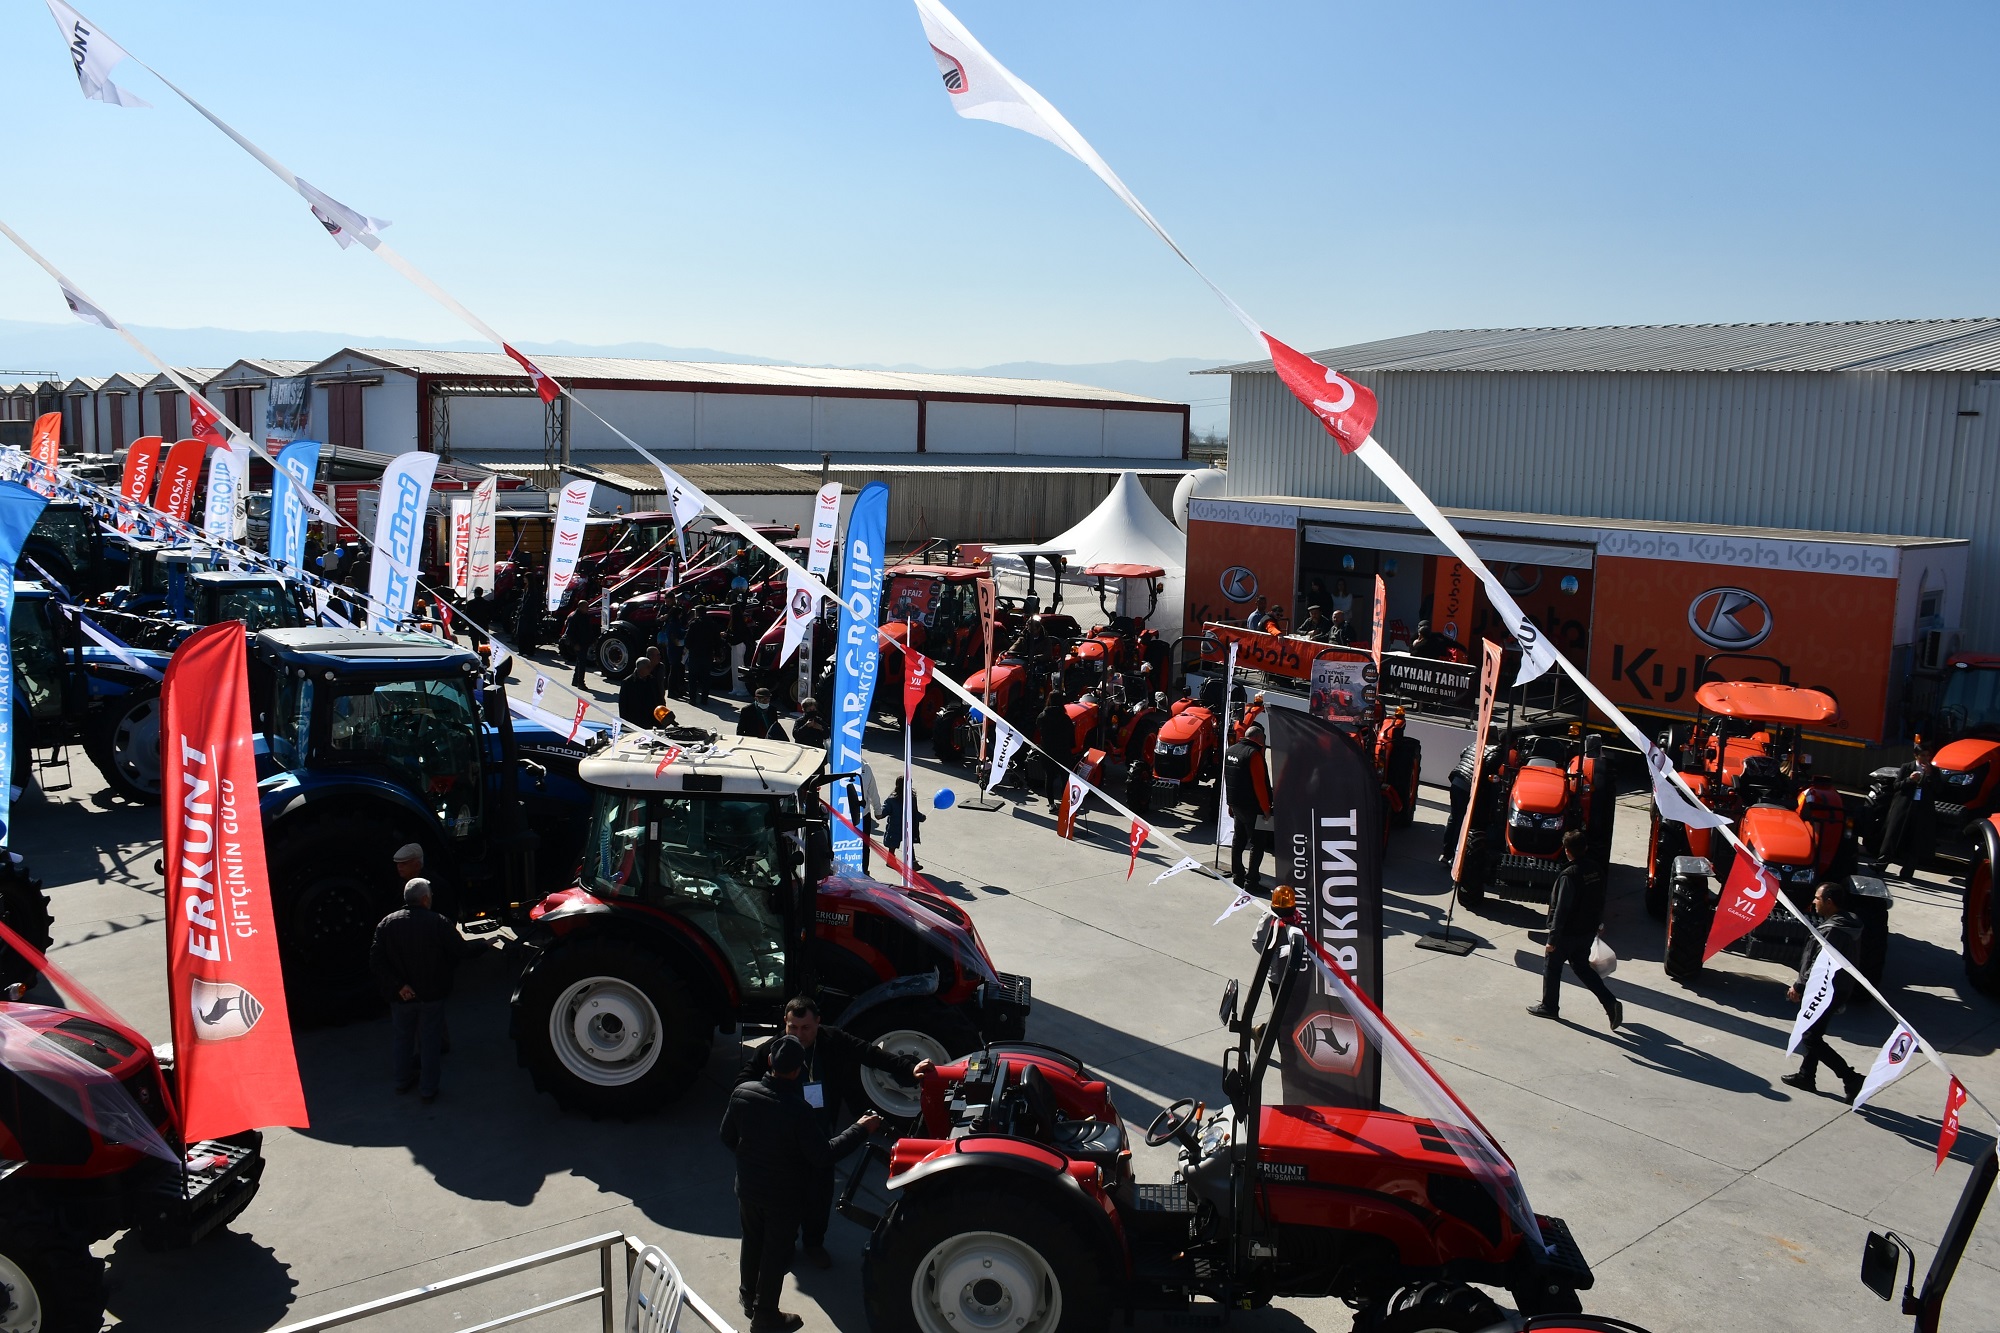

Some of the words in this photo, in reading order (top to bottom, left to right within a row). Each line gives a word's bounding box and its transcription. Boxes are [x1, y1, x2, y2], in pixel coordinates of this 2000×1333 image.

[1192, 502, 1239, 521] Kubota
[1244, 506, 1295, 526] Kubota
[1597, 532, 1680, 558] Kubota
[1688, 538, 1780, 567] Kubota
[1787, 545, 1888, 575] Kubota
[845, 540, 872, 676] GROUP
[1447, 563, 1463, 618] Kubota
[1390, 664, 1433, 684] KAYHAN
[1435, 671, 1470, 690] TARIM
[1400, 682, 1417, 692] AYDIN
[1418, 685, 1438, 696] BÖLGE
[997, 727, 1015, 769] ERKUNT
[220, 778, 239, 835] GÜCÜ
[181, 734, 221, 962] ERKUNT
[224, 842, 258, 938] ÇİFTÇİNİN
[1733, 896, 1757, 917] YIL
[815, 910, 850, 921] ERKUNT
